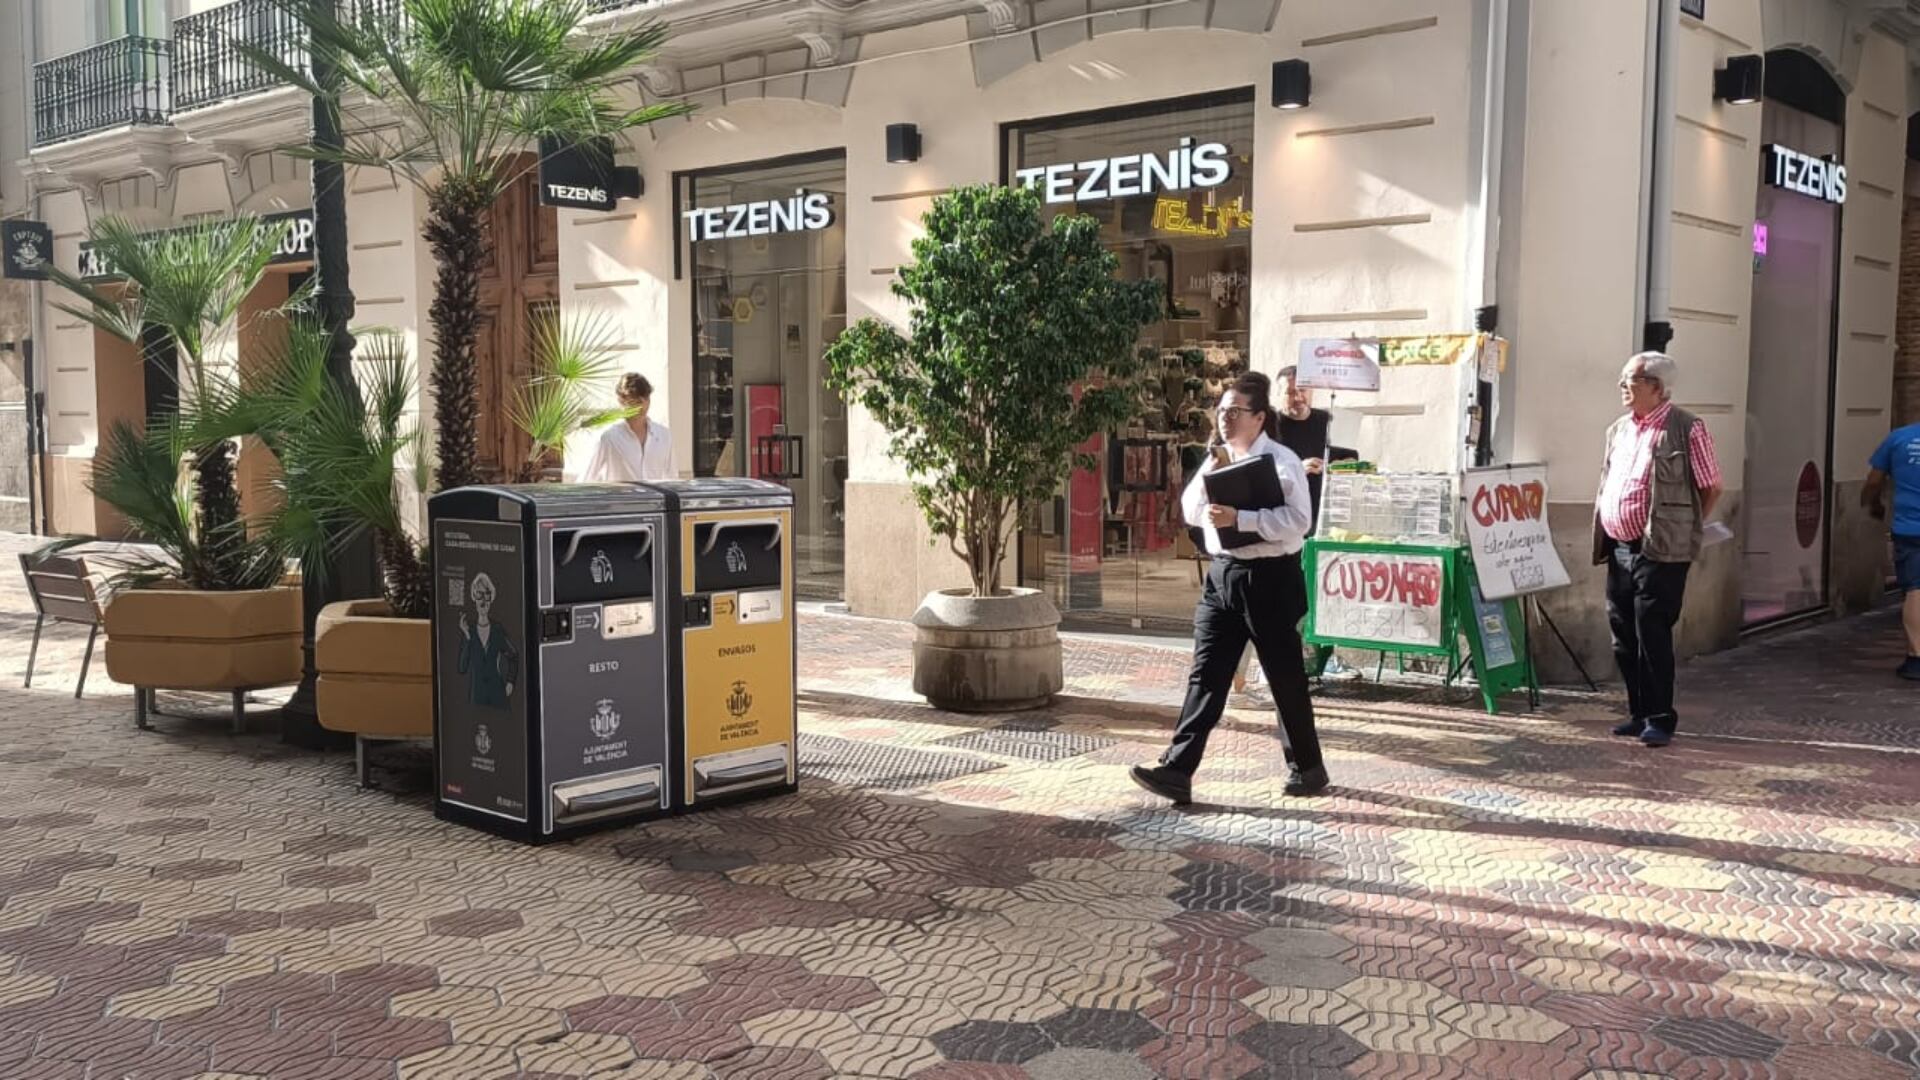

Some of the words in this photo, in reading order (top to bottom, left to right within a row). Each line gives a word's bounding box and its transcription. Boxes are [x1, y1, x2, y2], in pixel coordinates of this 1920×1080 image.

[1016, 136, 1230, 204] TEZENIS
[1773, 143, 1847, 204] TEZENIS
[548, 184, 608, 203] TEZENIS
[682, 188, 830, 242] TEZENIS
[589, 660, 619, 673] RESTO
[718, 643, 756, 657] ENVASOS
